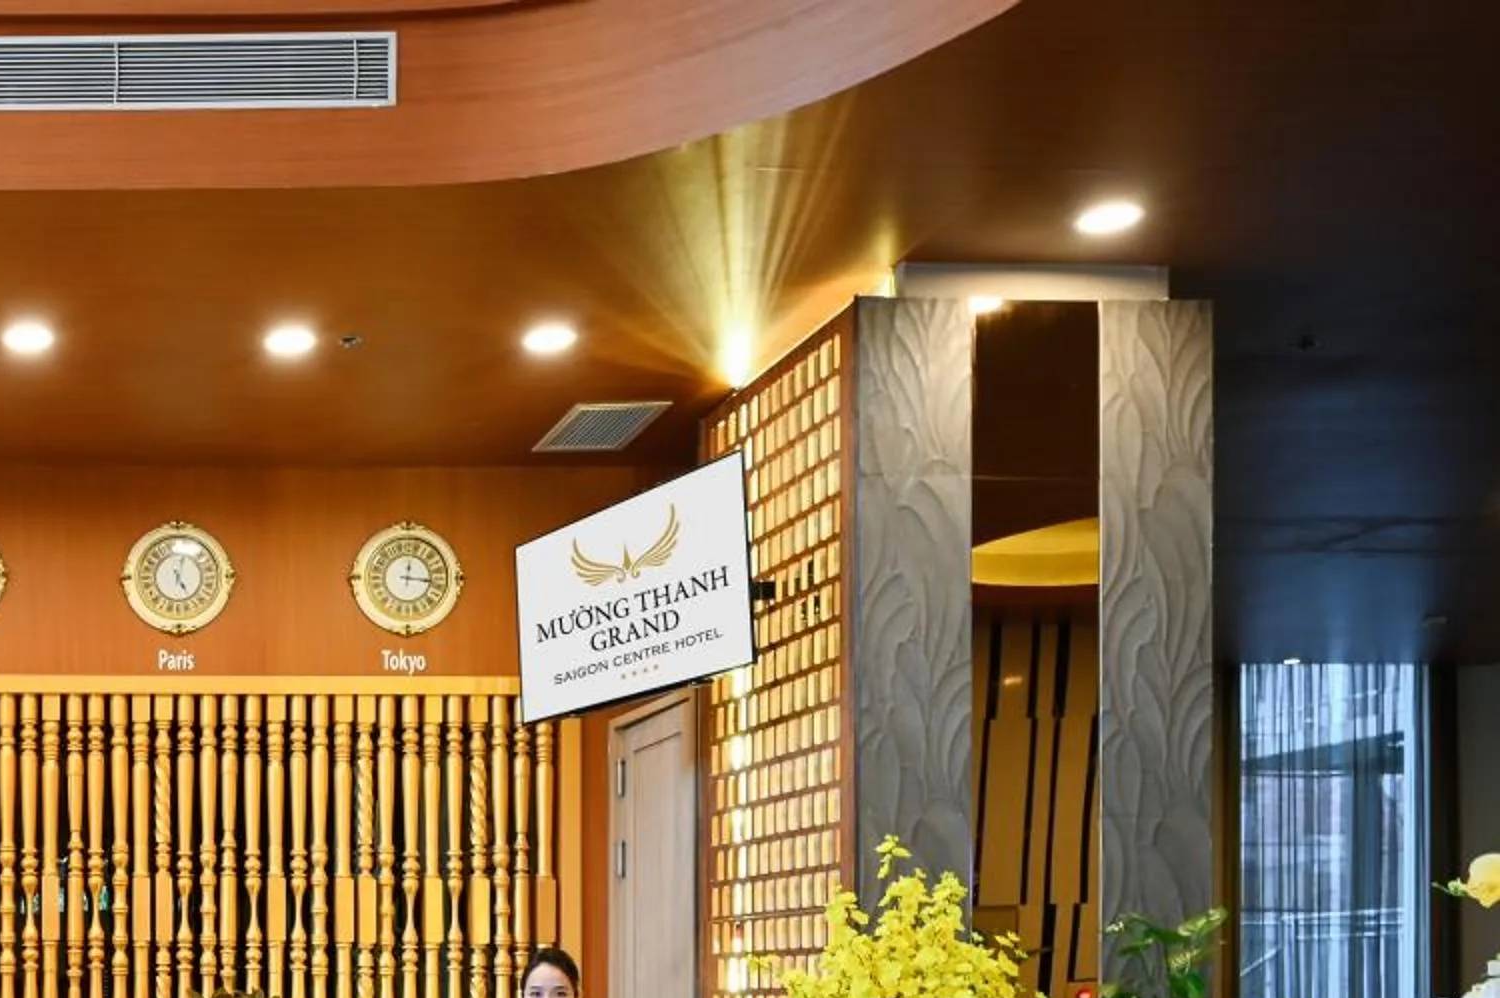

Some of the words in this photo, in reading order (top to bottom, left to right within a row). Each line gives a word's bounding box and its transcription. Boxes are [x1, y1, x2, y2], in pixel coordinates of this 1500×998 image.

[536, 597, 630, 643] MƯỜNG
[634, 566, 729, 611] THANH
[590, 609, 680, 652] GRAND
[158, 648, 196, 670] Paris
[381, 648, 426, 676] Tokyo
[553, 659, 610, 685] SAIGON
[613, 641, 671, 668] CENTRE
[675, 627, 723, 650] HOTEL
